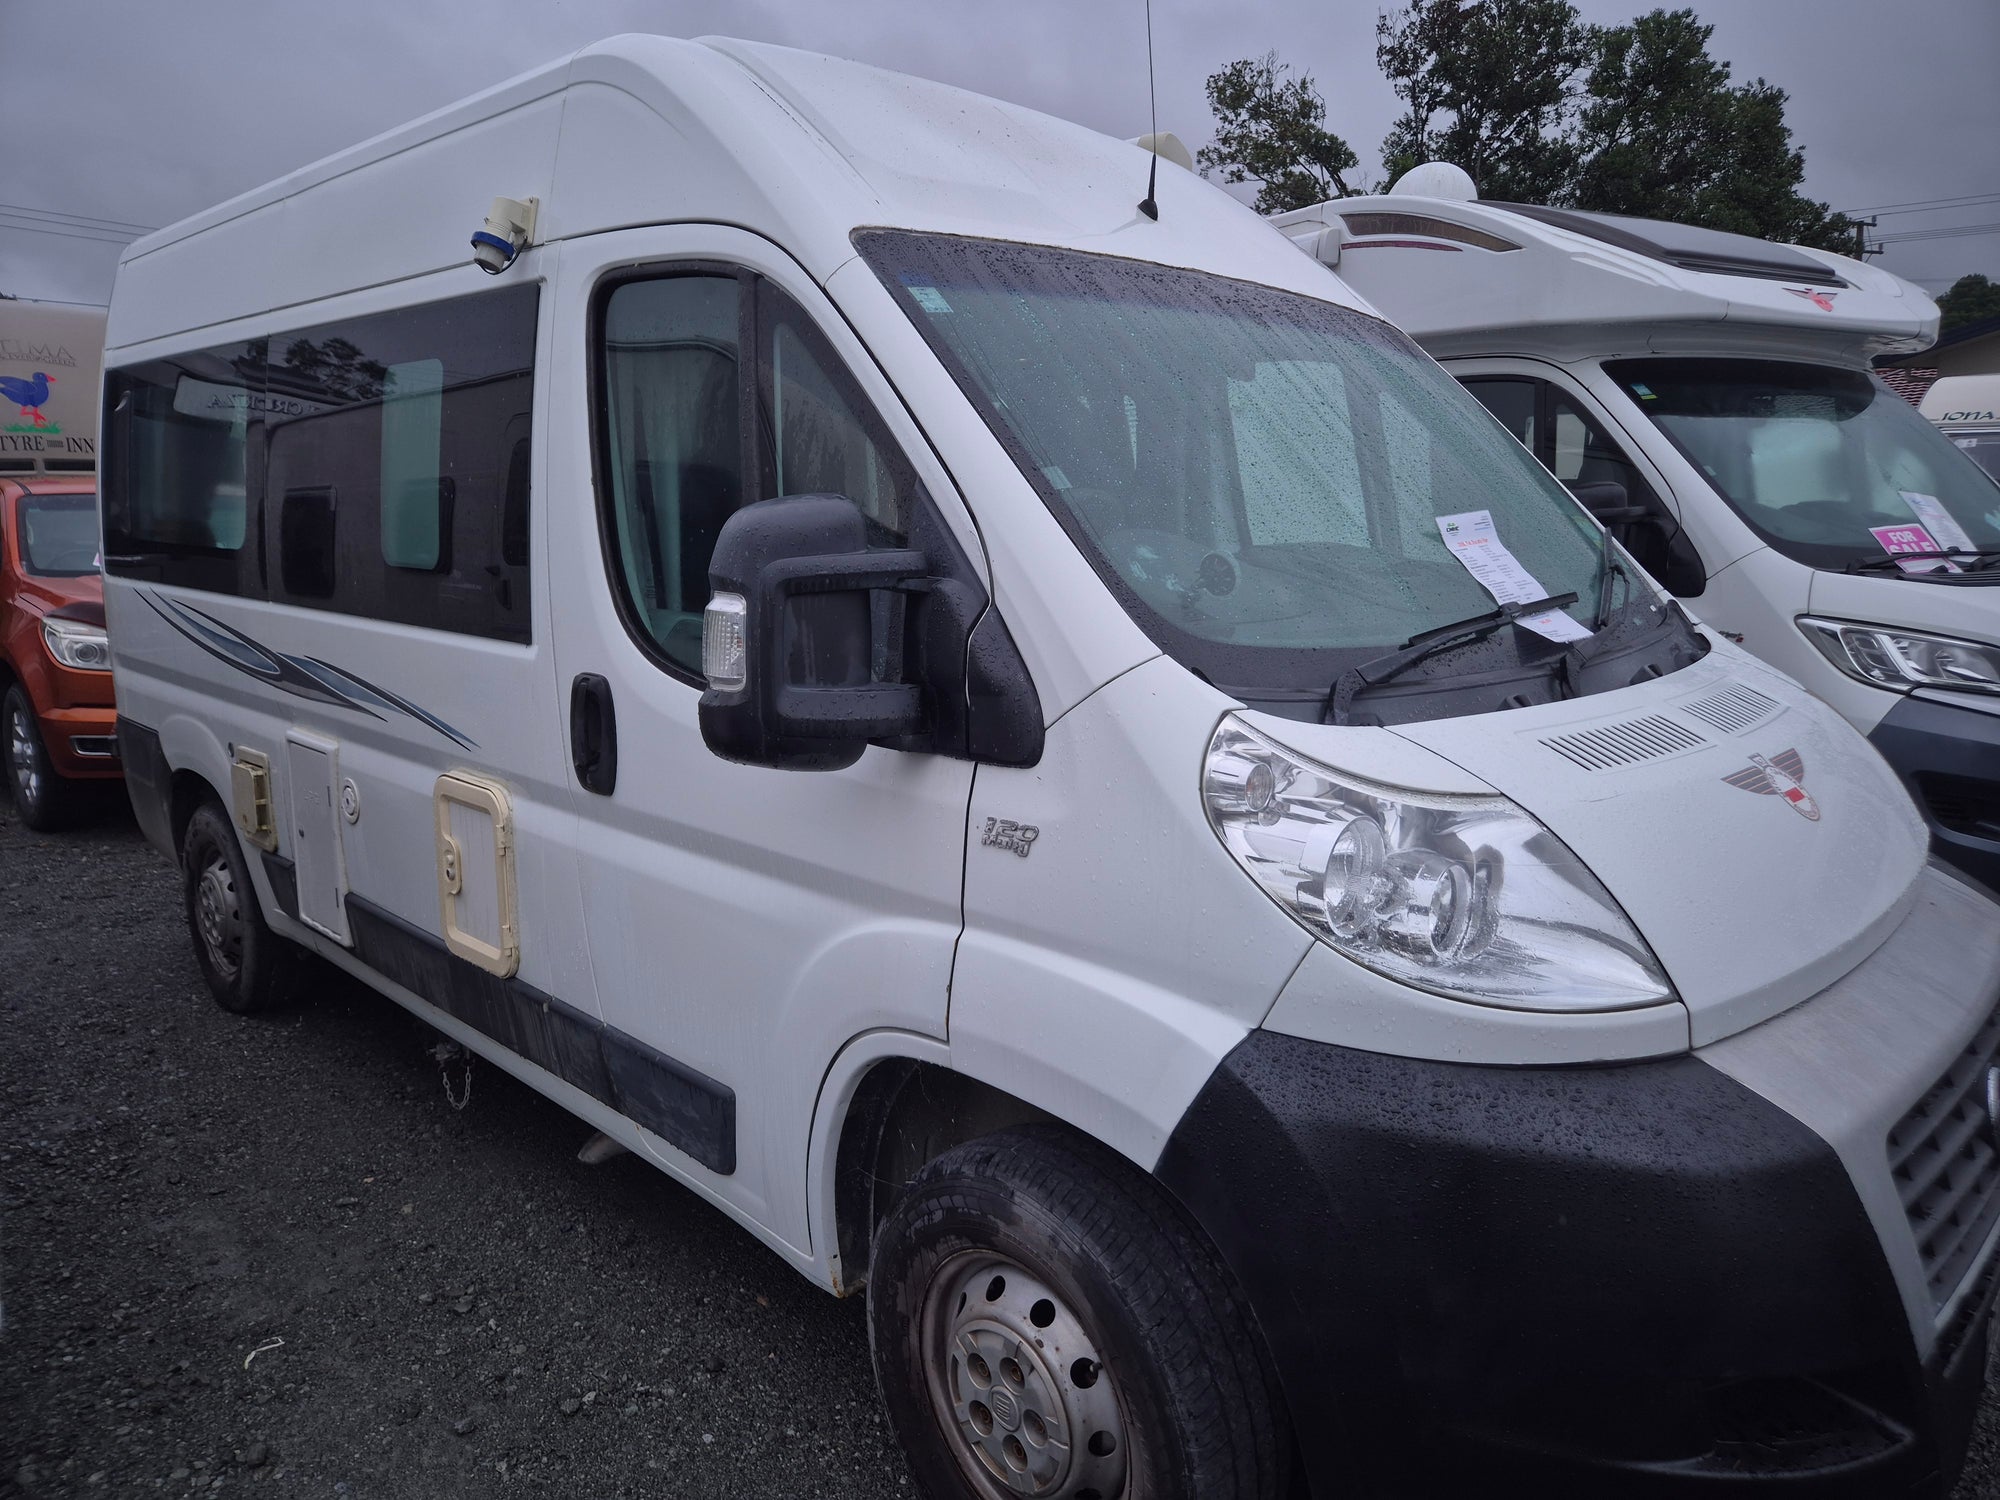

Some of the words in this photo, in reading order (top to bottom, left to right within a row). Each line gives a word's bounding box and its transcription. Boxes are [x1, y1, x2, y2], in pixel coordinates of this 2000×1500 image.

[0, 435, 45, 452] TYRE
[1888, 530, 1917, 544] FOR
[984, 816, 1040, 843] 120
